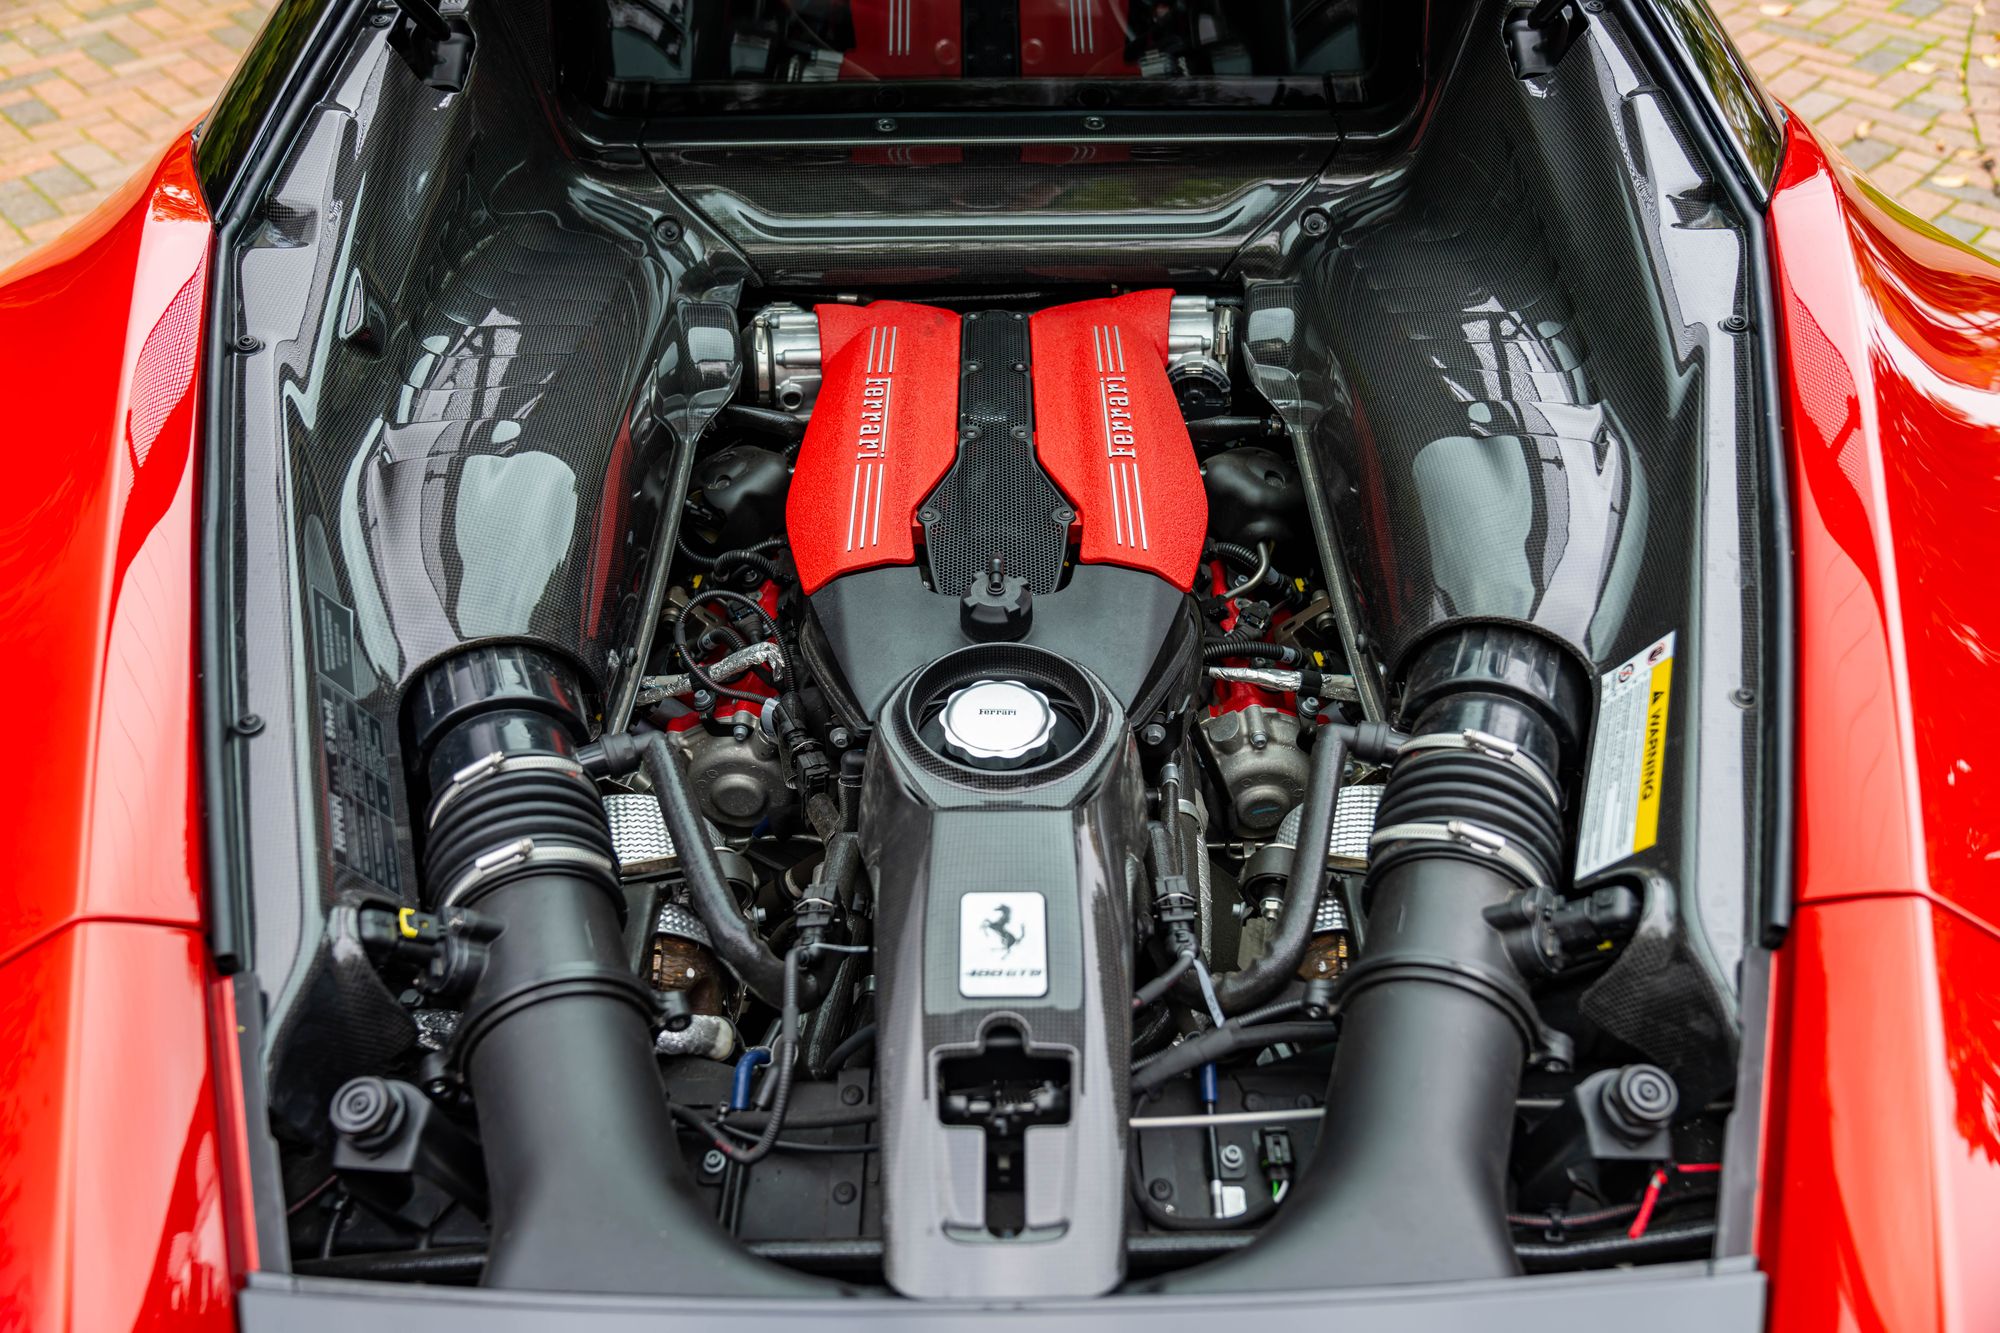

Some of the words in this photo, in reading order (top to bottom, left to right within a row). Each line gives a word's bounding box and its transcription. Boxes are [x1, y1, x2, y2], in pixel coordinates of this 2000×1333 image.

[857, 378, 892, 460] Ferrari
[1100, 376, 1136, 458] Ferrari
[978, 708, 1017, 716] Ferrari
[1642, 708, 1661, 800] WARNING
